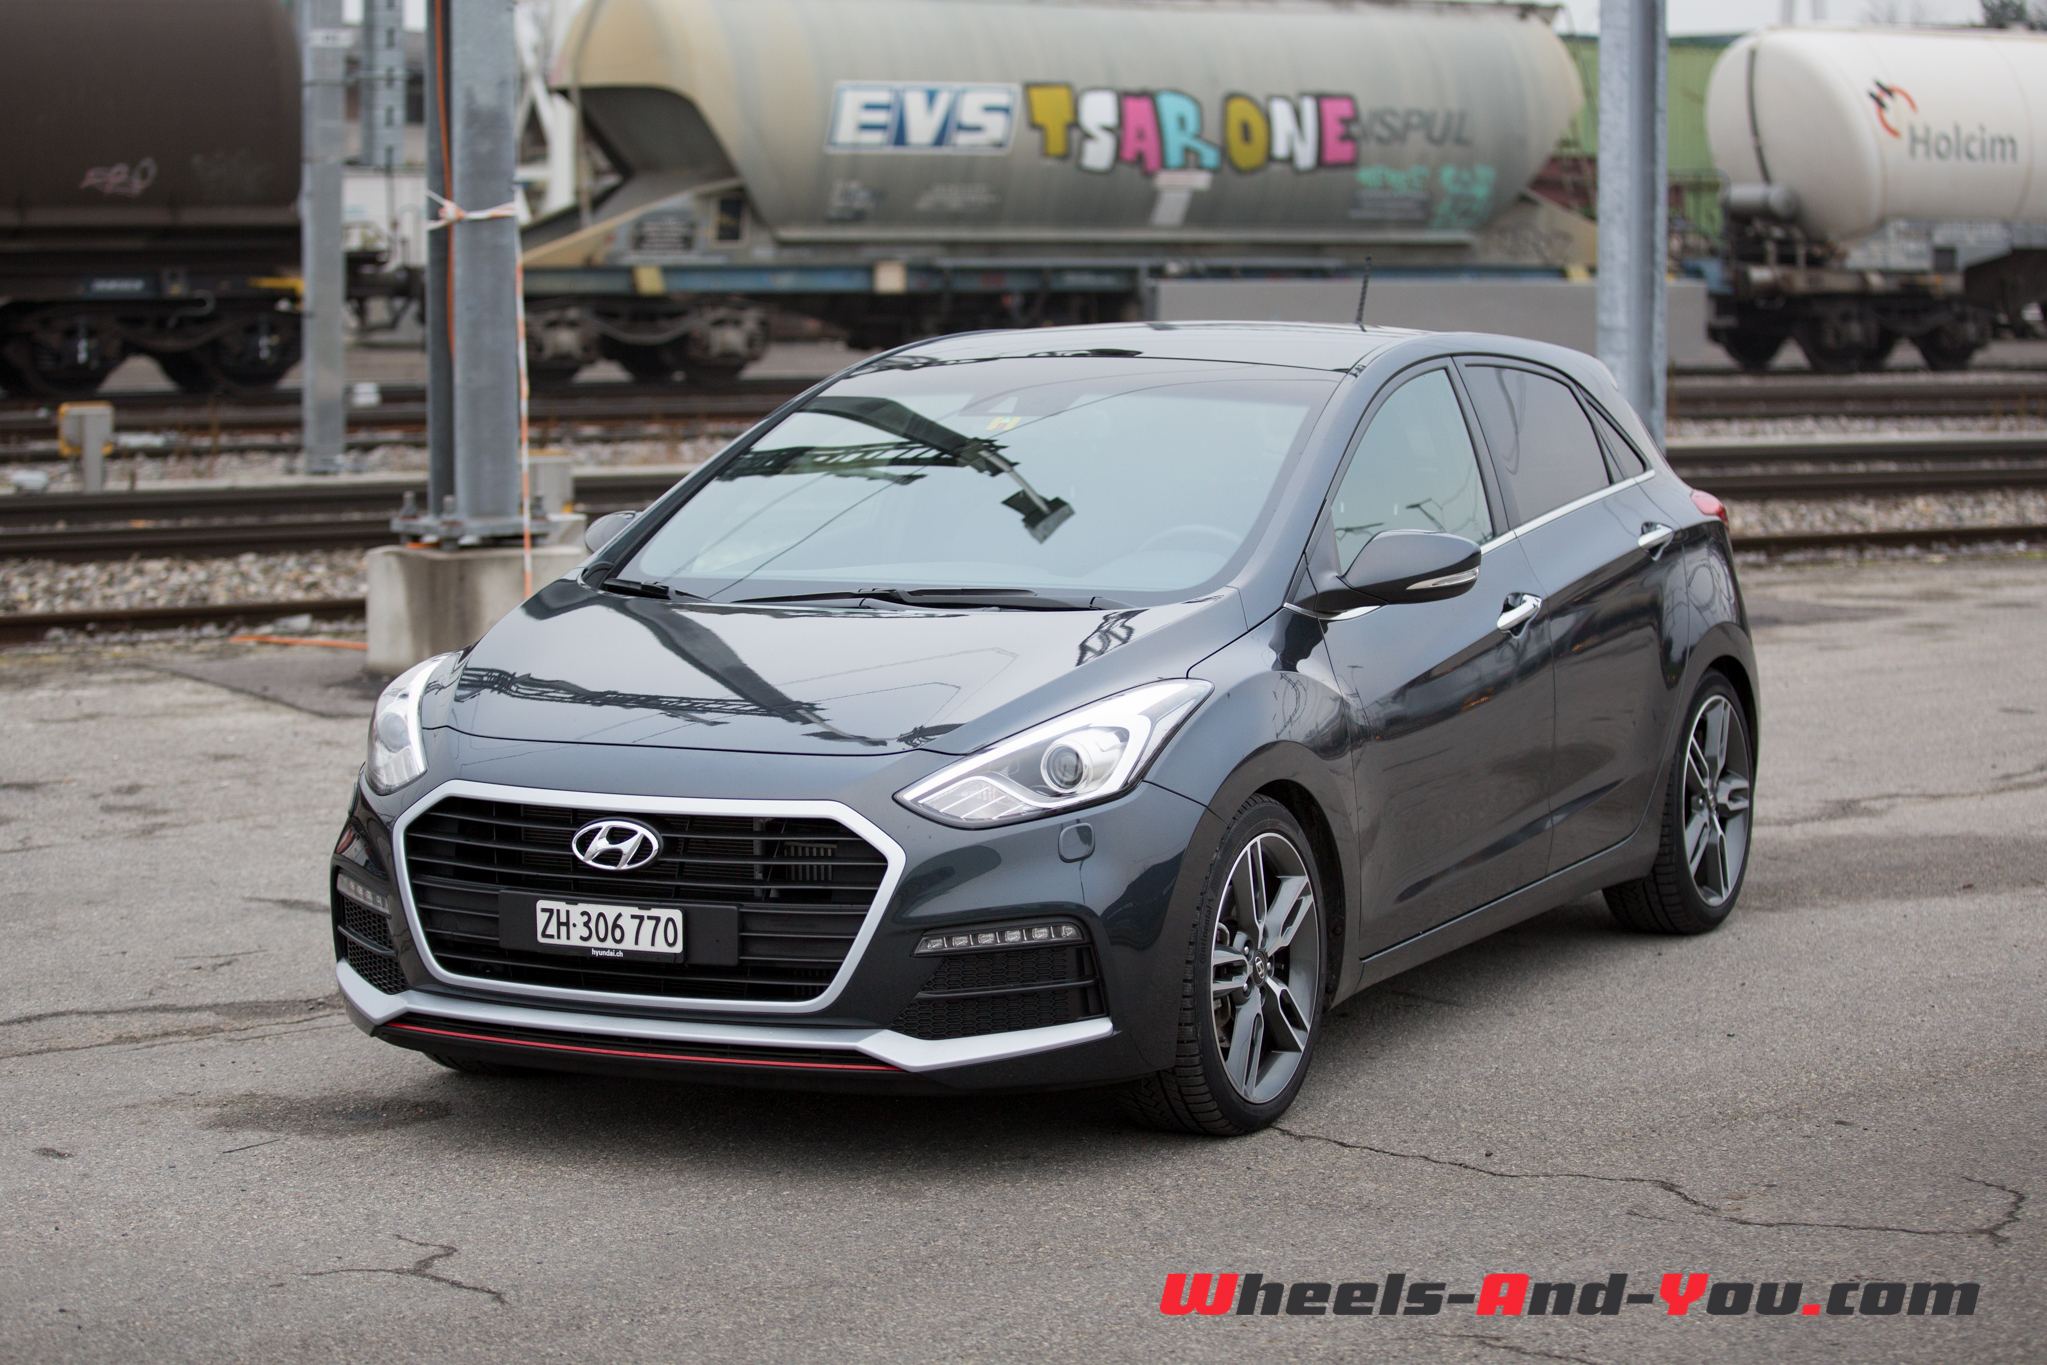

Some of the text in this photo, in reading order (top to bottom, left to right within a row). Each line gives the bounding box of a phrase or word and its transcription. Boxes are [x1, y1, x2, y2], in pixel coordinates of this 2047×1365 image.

[830, 84, 1015, 150] EVS
[1024, 81, 1358, 173] TSAR ONE
[1909, 122, 2018, 162] Holcim
[591, 947, 624, 958] hyundai.ch
[1201, 904, 1213, 964] Continental
